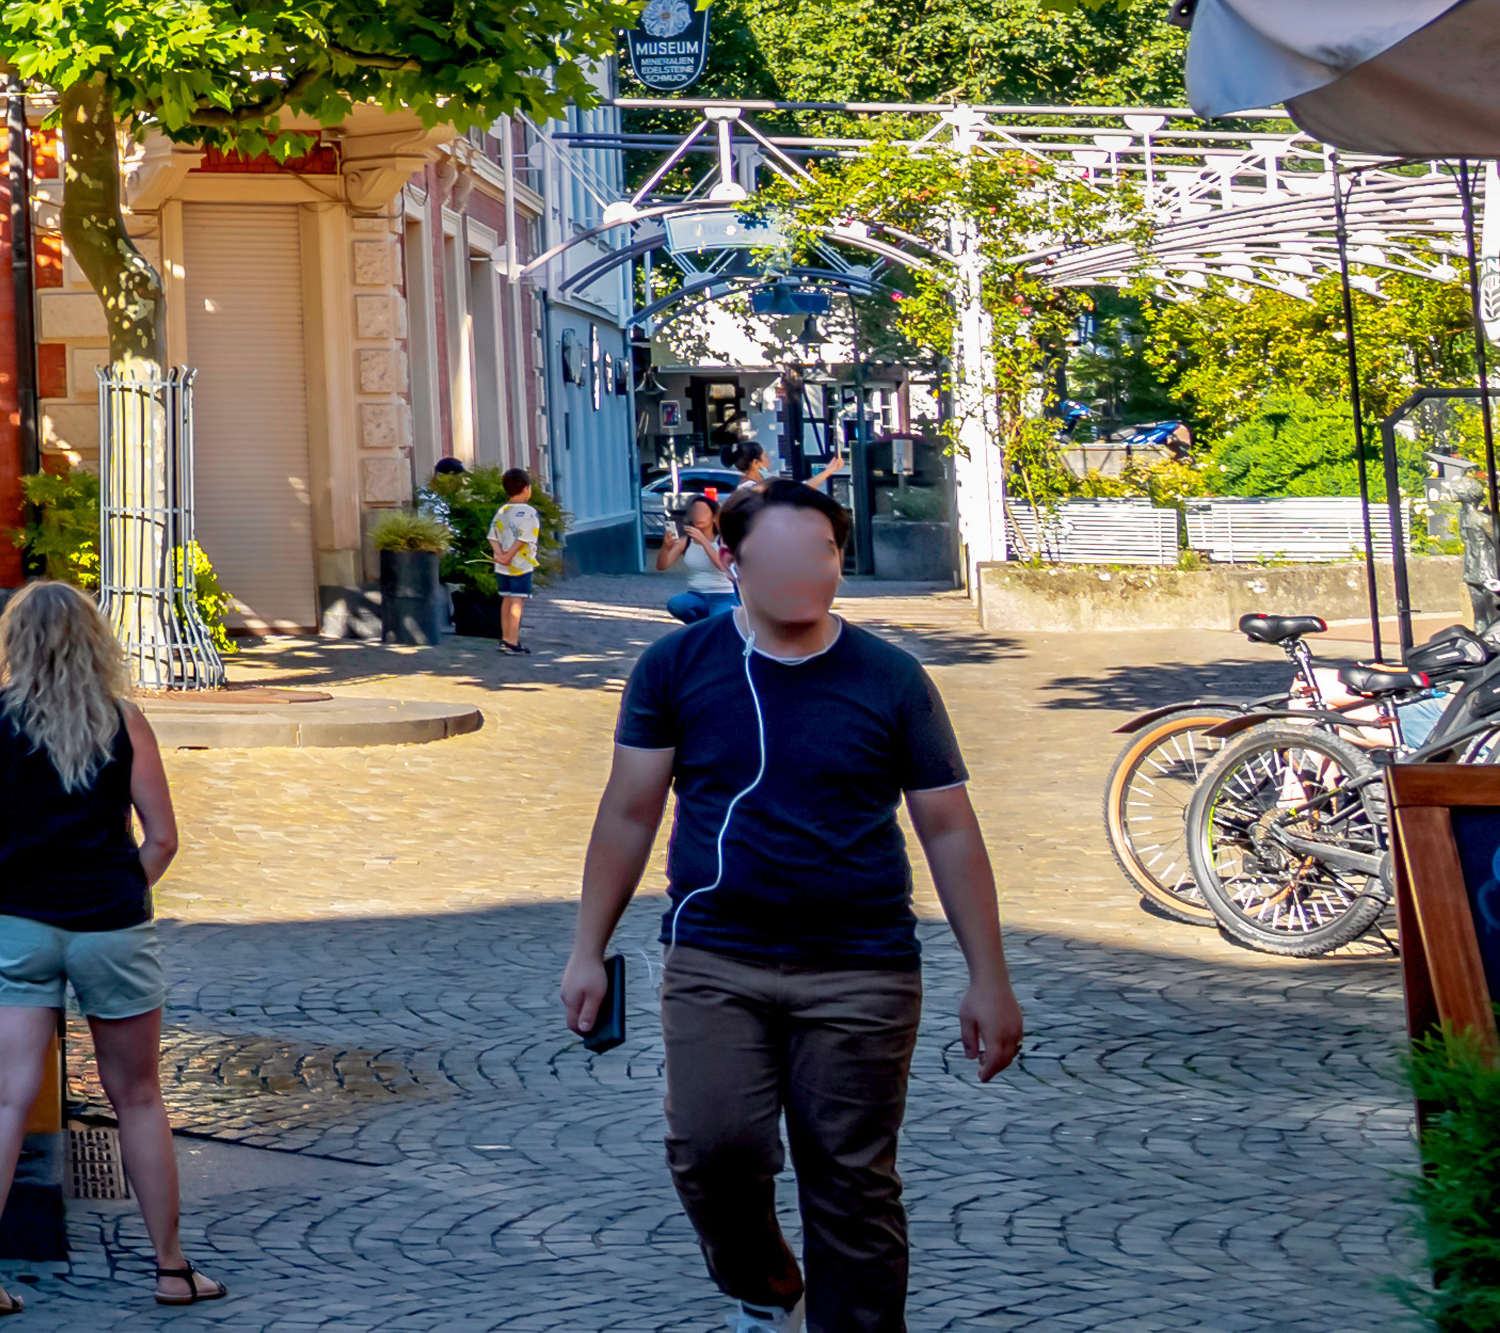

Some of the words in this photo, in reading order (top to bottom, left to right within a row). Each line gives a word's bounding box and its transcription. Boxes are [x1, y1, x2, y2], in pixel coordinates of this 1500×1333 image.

[635, 40, 699, 56] MUSEUM
[640, 56, 695, 66] MINERALIEN
[641, 65, 694, 74] EDELSTEINE
[644, 73, 689, 83] SCHMUCK
